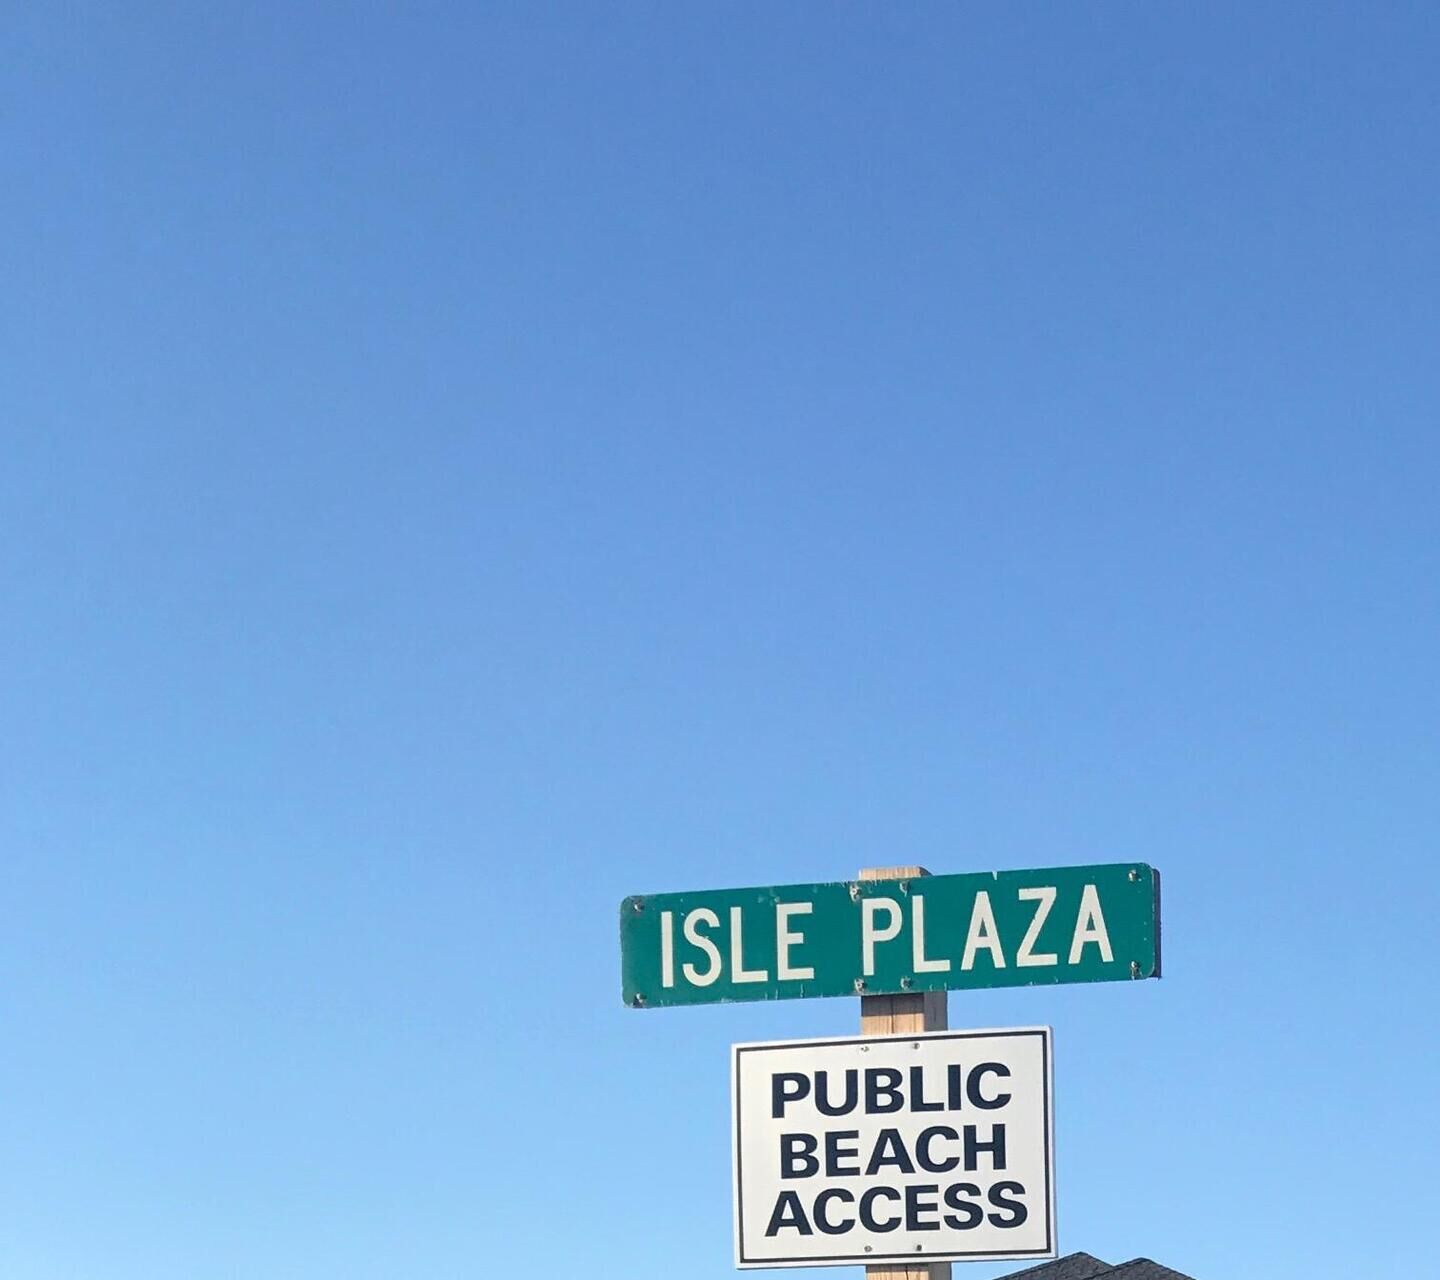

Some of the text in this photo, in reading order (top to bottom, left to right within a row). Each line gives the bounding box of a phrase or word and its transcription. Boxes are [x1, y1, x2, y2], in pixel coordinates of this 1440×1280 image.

[660, 884, 1115, 988] ISLE PLAZA
[771, 1062, 1012, 1119] PUBLIC
[780, 1123, 1007, 1179] BEACH
[764, 1180, 1028, 1237] ACCESS
